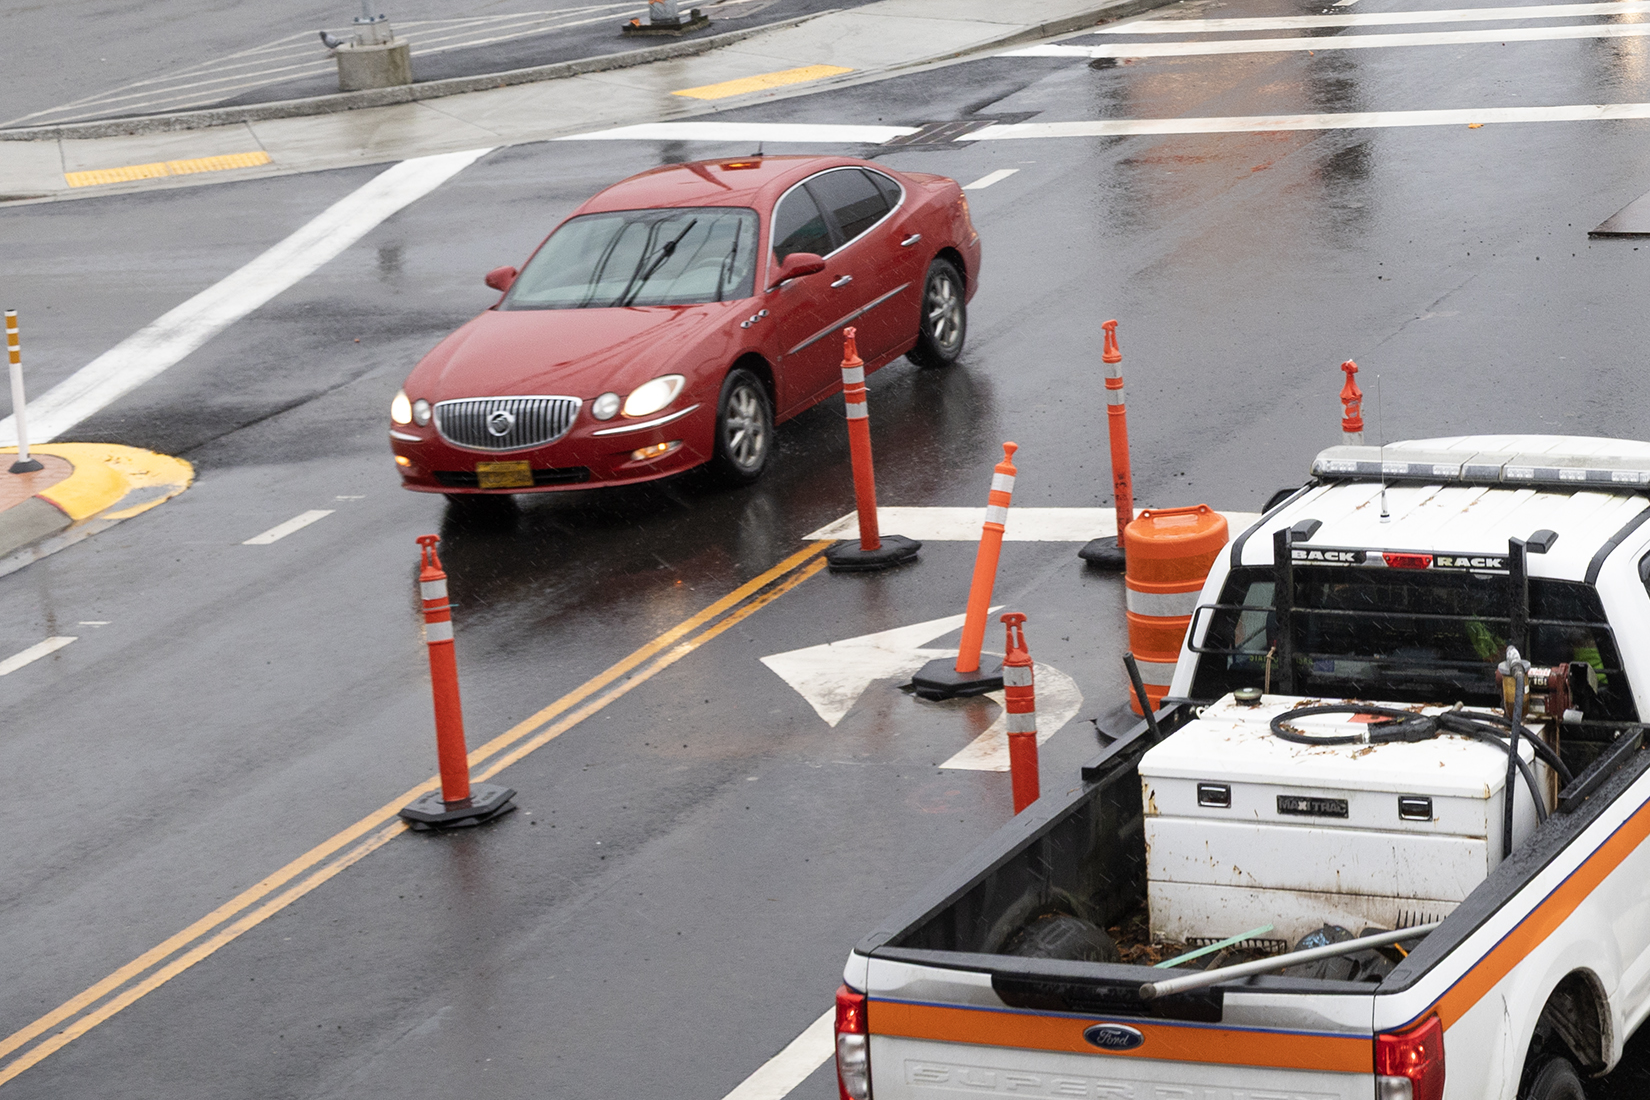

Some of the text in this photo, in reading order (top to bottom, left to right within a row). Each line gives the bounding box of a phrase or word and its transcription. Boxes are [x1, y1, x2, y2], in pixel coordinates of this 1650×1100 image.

[1291, 550, 1503, 568] BACK RACK
[1097, 1028, 1129, 1046] Ford
[912, 1065, 1135, 1099] SUPER
